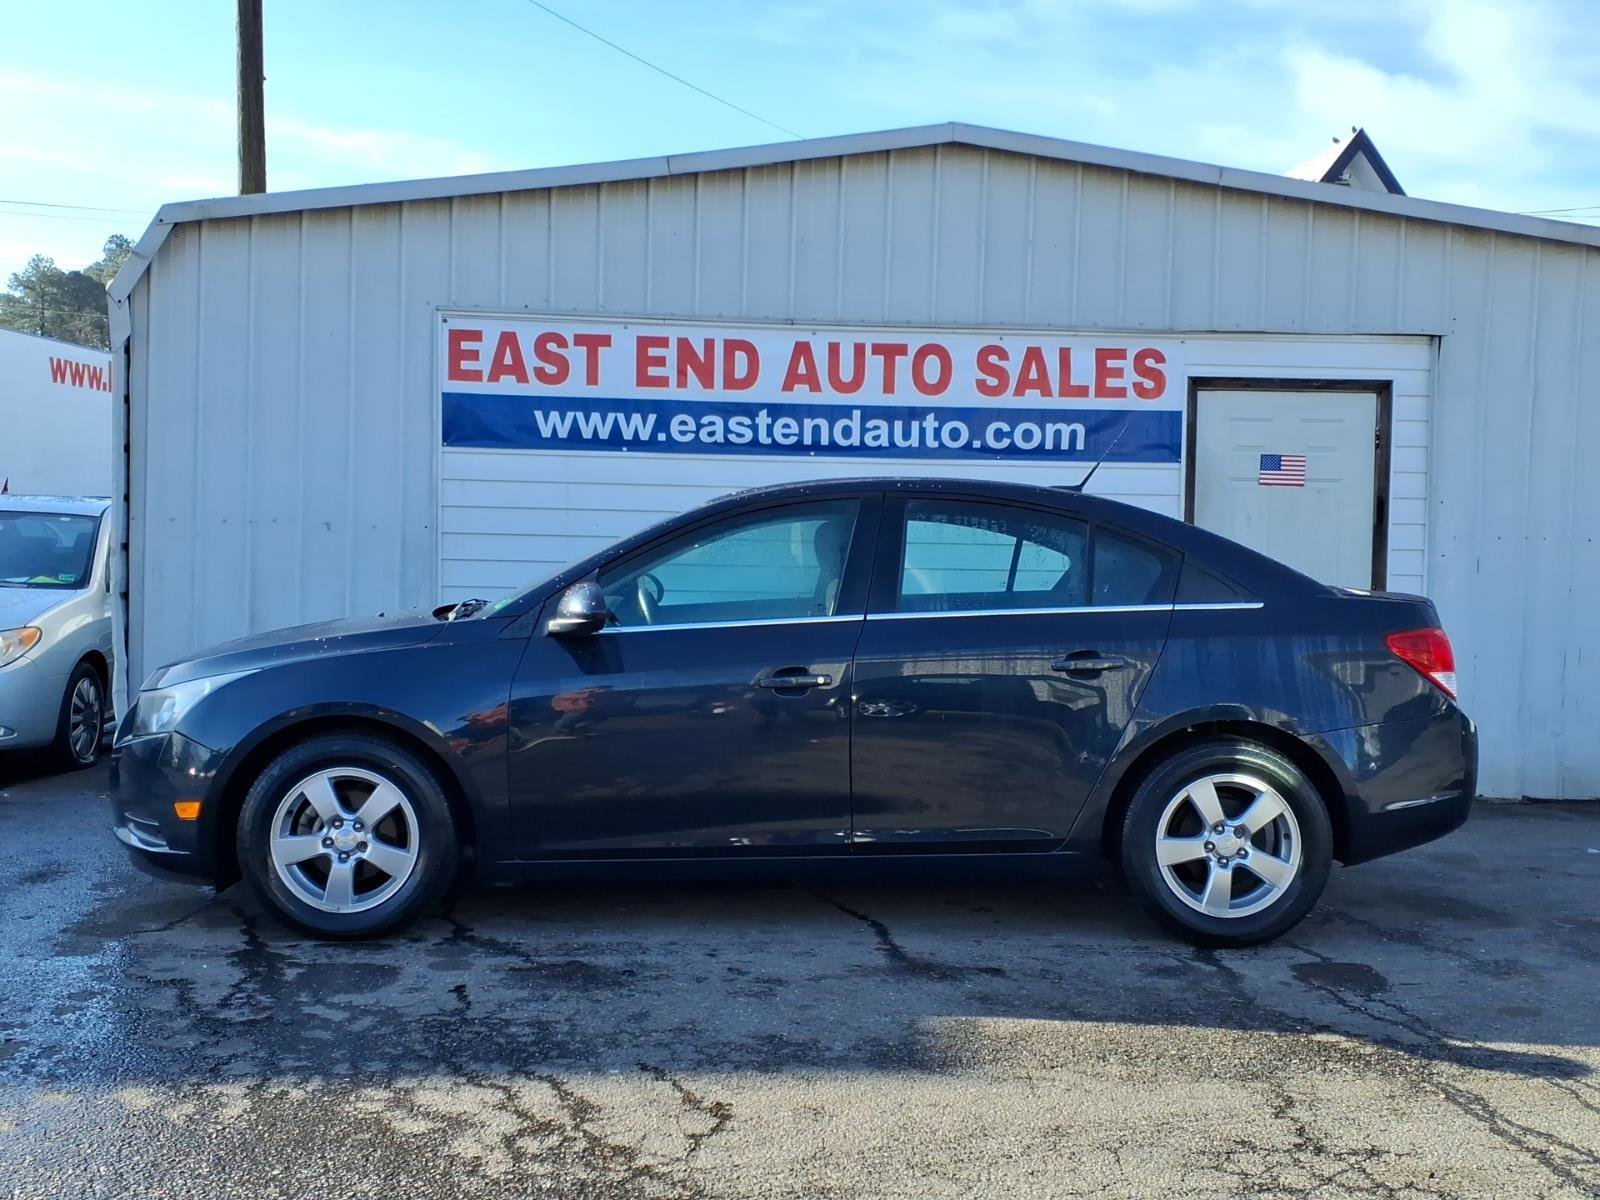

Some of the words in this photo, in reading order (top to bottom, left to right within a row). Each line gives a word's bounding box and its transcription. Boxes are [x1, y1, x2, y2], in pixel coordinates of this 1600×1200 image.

[448, 329, 612, 386] EAST
[635, 335, 760, 391] END
[781, 340, 953, 396] AUTO
[975, 344, 1167, 400] SALES
[533, 408, 1086, 451] www.eastendauto.com
